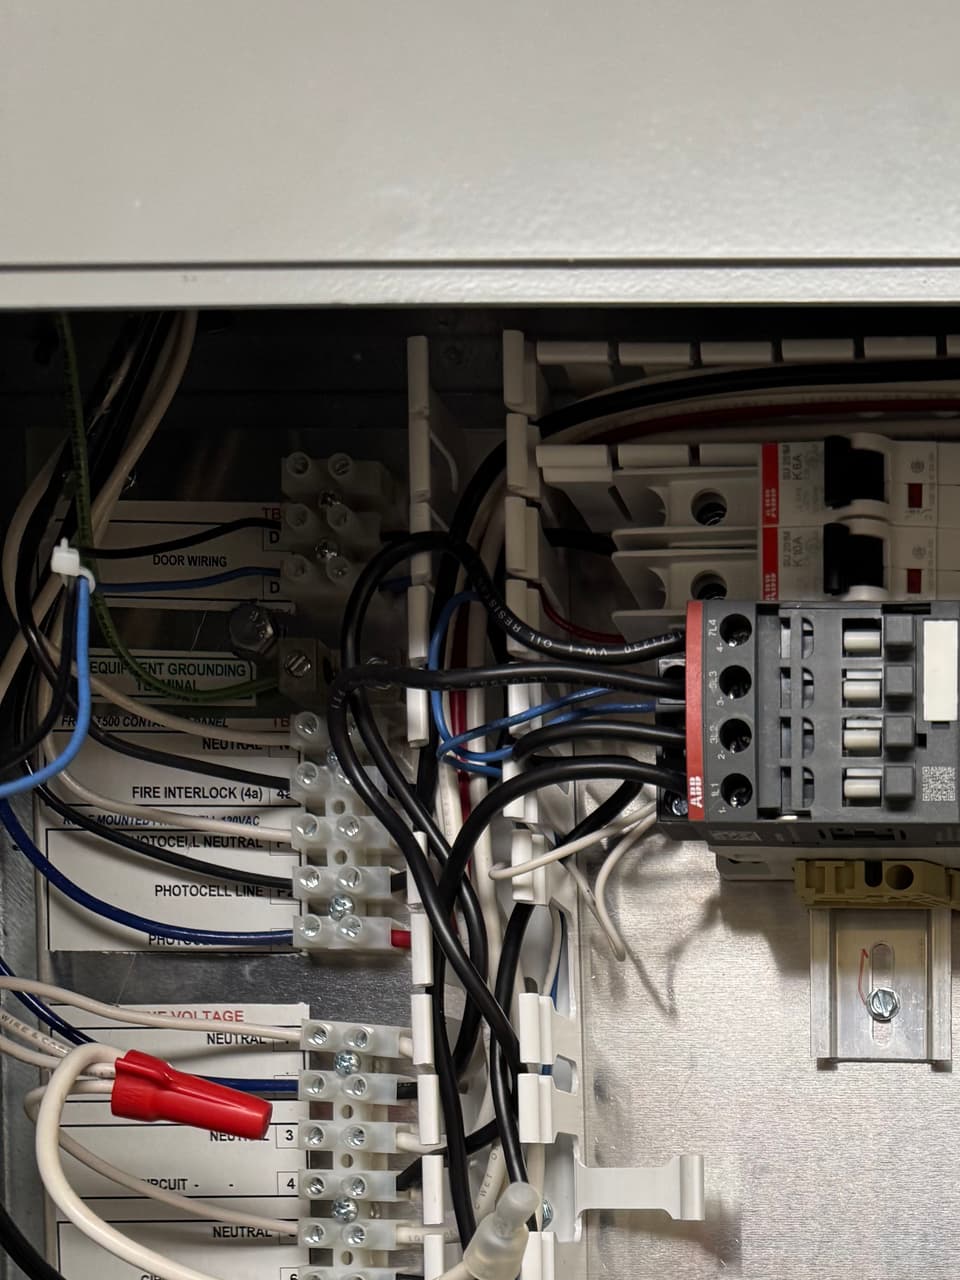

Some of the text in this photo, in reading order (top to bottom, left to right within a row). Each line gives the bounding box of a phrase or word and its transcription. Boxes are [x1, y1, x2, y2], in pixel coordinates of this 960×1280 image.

[153, 555, 227, 567] DOOR WIRING
[168, 663, 246, 677] GROUNDING
[133, 787, 263, 802] FIRE INTERLOCK (4a)
[690, 776, 703, 808] ABB
[203, 836, 263, 848] NEUTRAL
[155, 885, 264, 897] PHOTOCELL LINE
[286, 1130, 293, 1141] 3
[287, 1179, 295, 1190] 4
